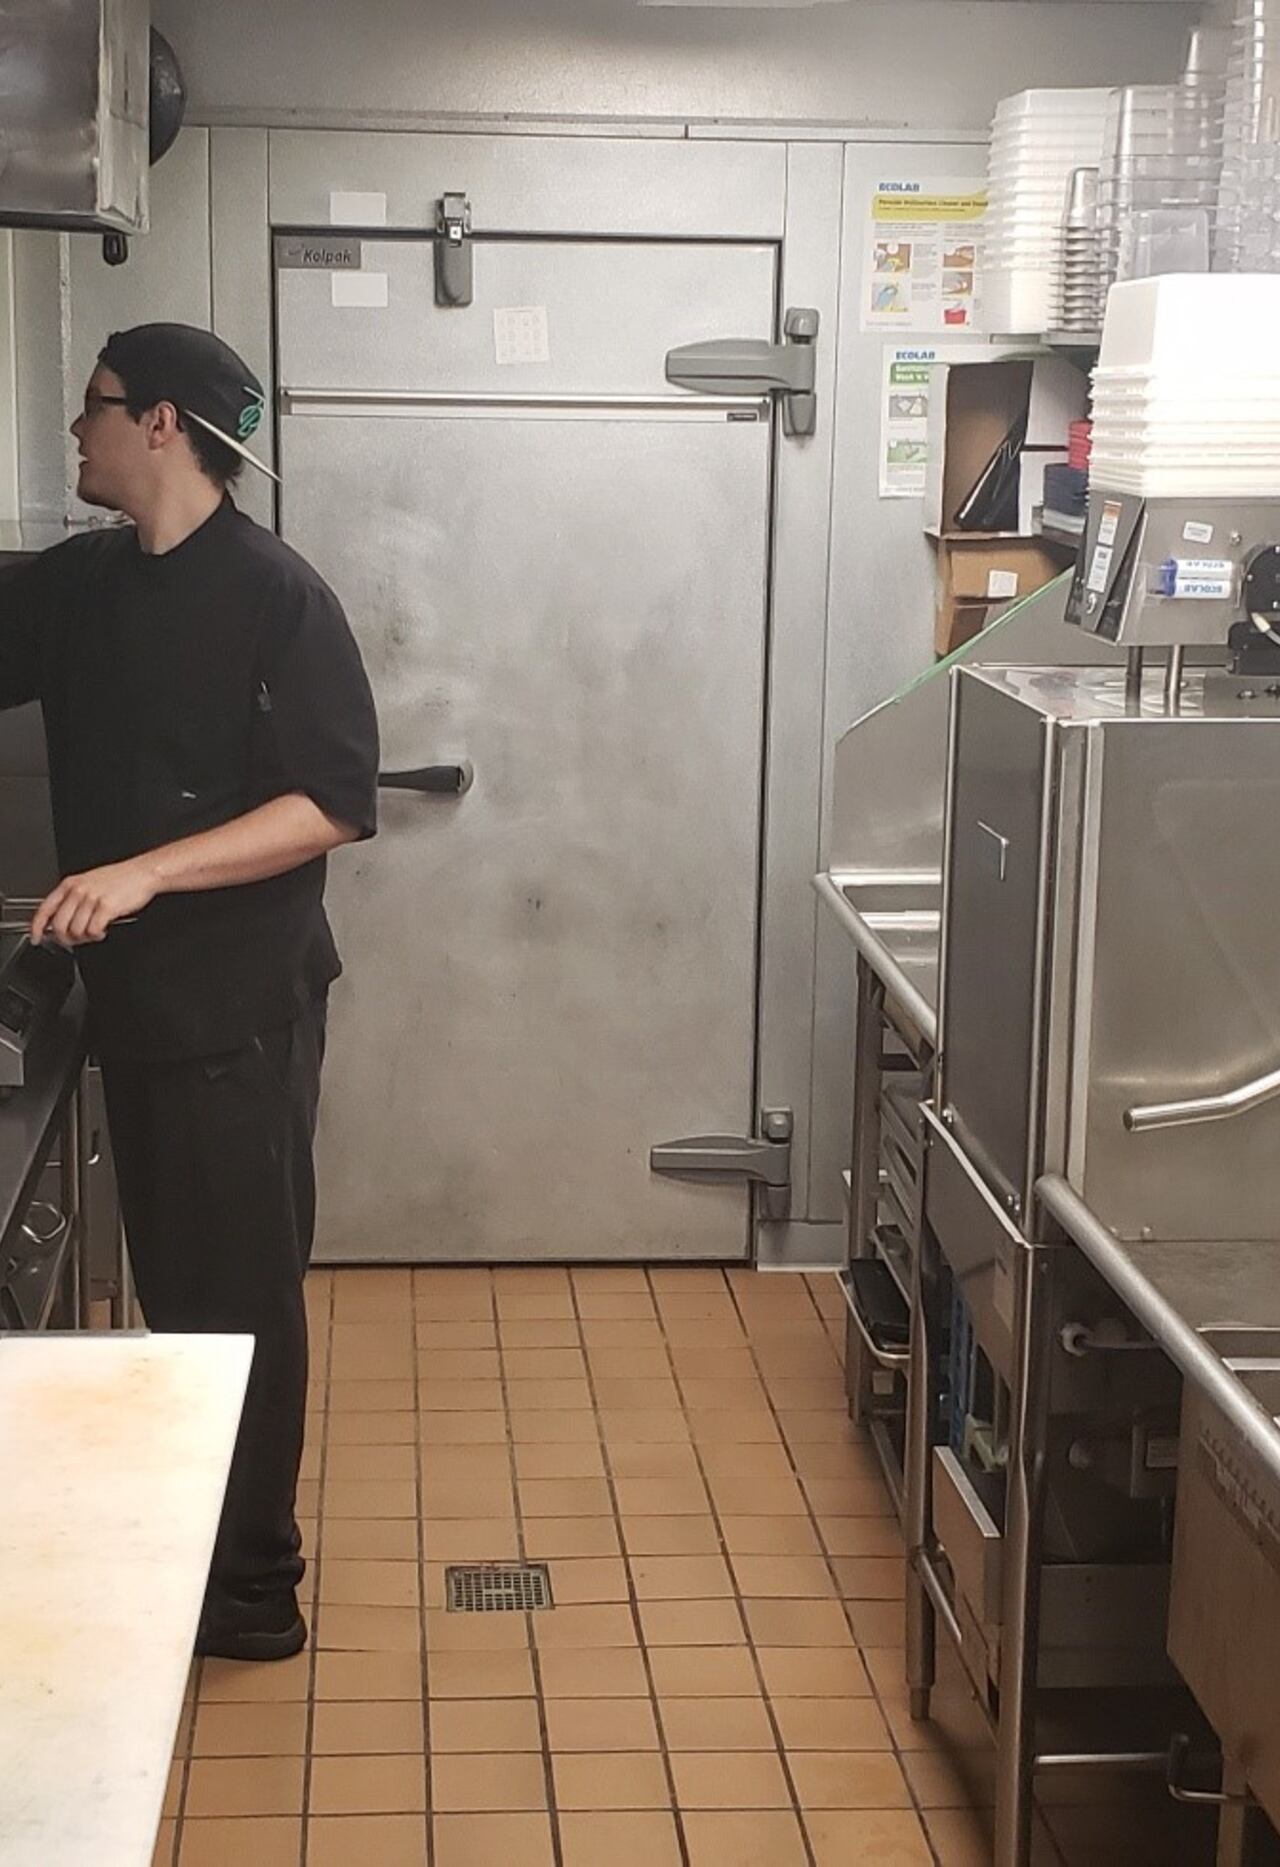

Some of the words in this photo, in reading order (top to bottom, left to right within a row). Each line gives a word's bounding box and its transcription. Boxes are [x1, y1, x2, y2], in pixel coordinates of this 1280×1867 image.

[878, 182, 920, 192] ECOLAB
[302, 247, 352, 266] Kolpak
[895, 351, 936, 360] ECOLAB
